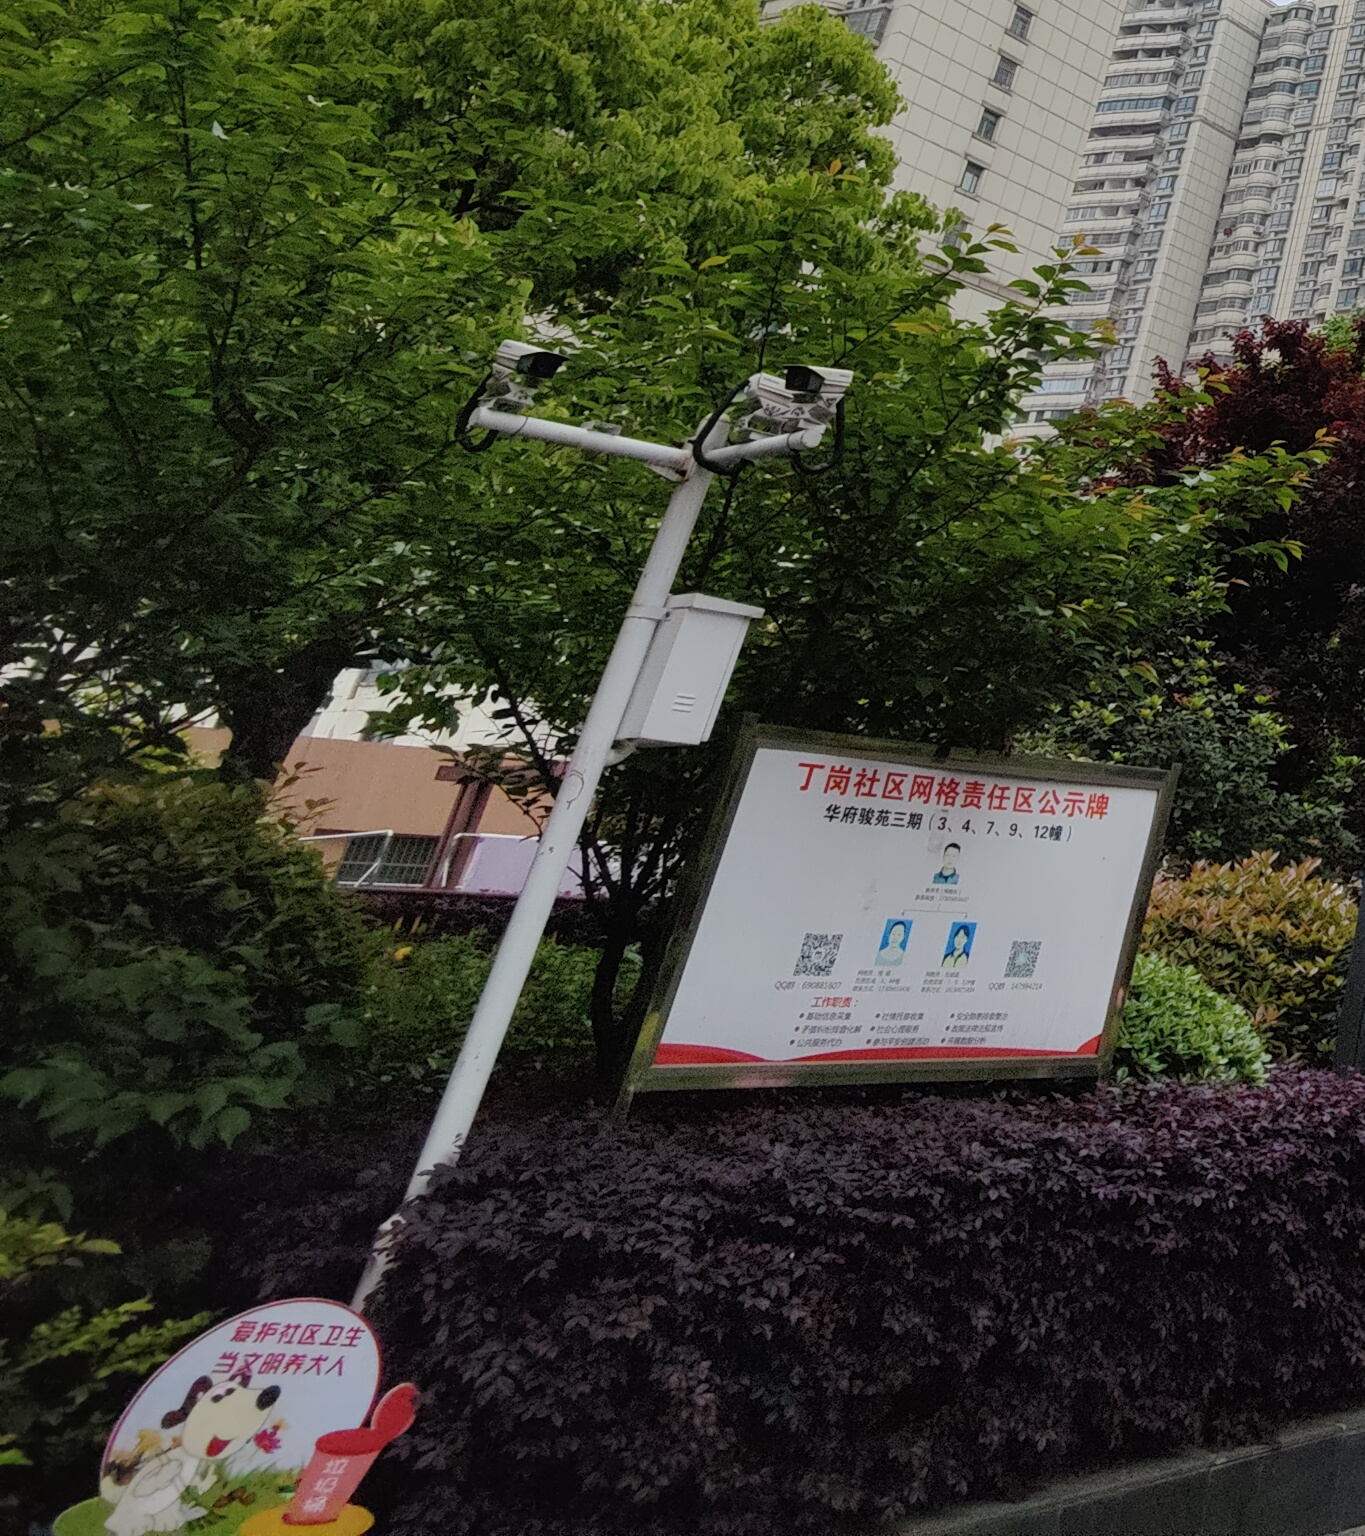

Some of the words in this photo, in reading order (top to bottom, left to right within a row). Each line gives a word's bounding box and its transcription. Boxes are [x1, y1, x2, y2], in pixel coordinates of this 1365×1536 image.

[798, 762, 1110, 820] 丁岗社区网格责任区公示牌
[229, 1320, 366, 1348] 爱护社区卫生
[212, 1351, 346, 1378] 当文明养犬人
